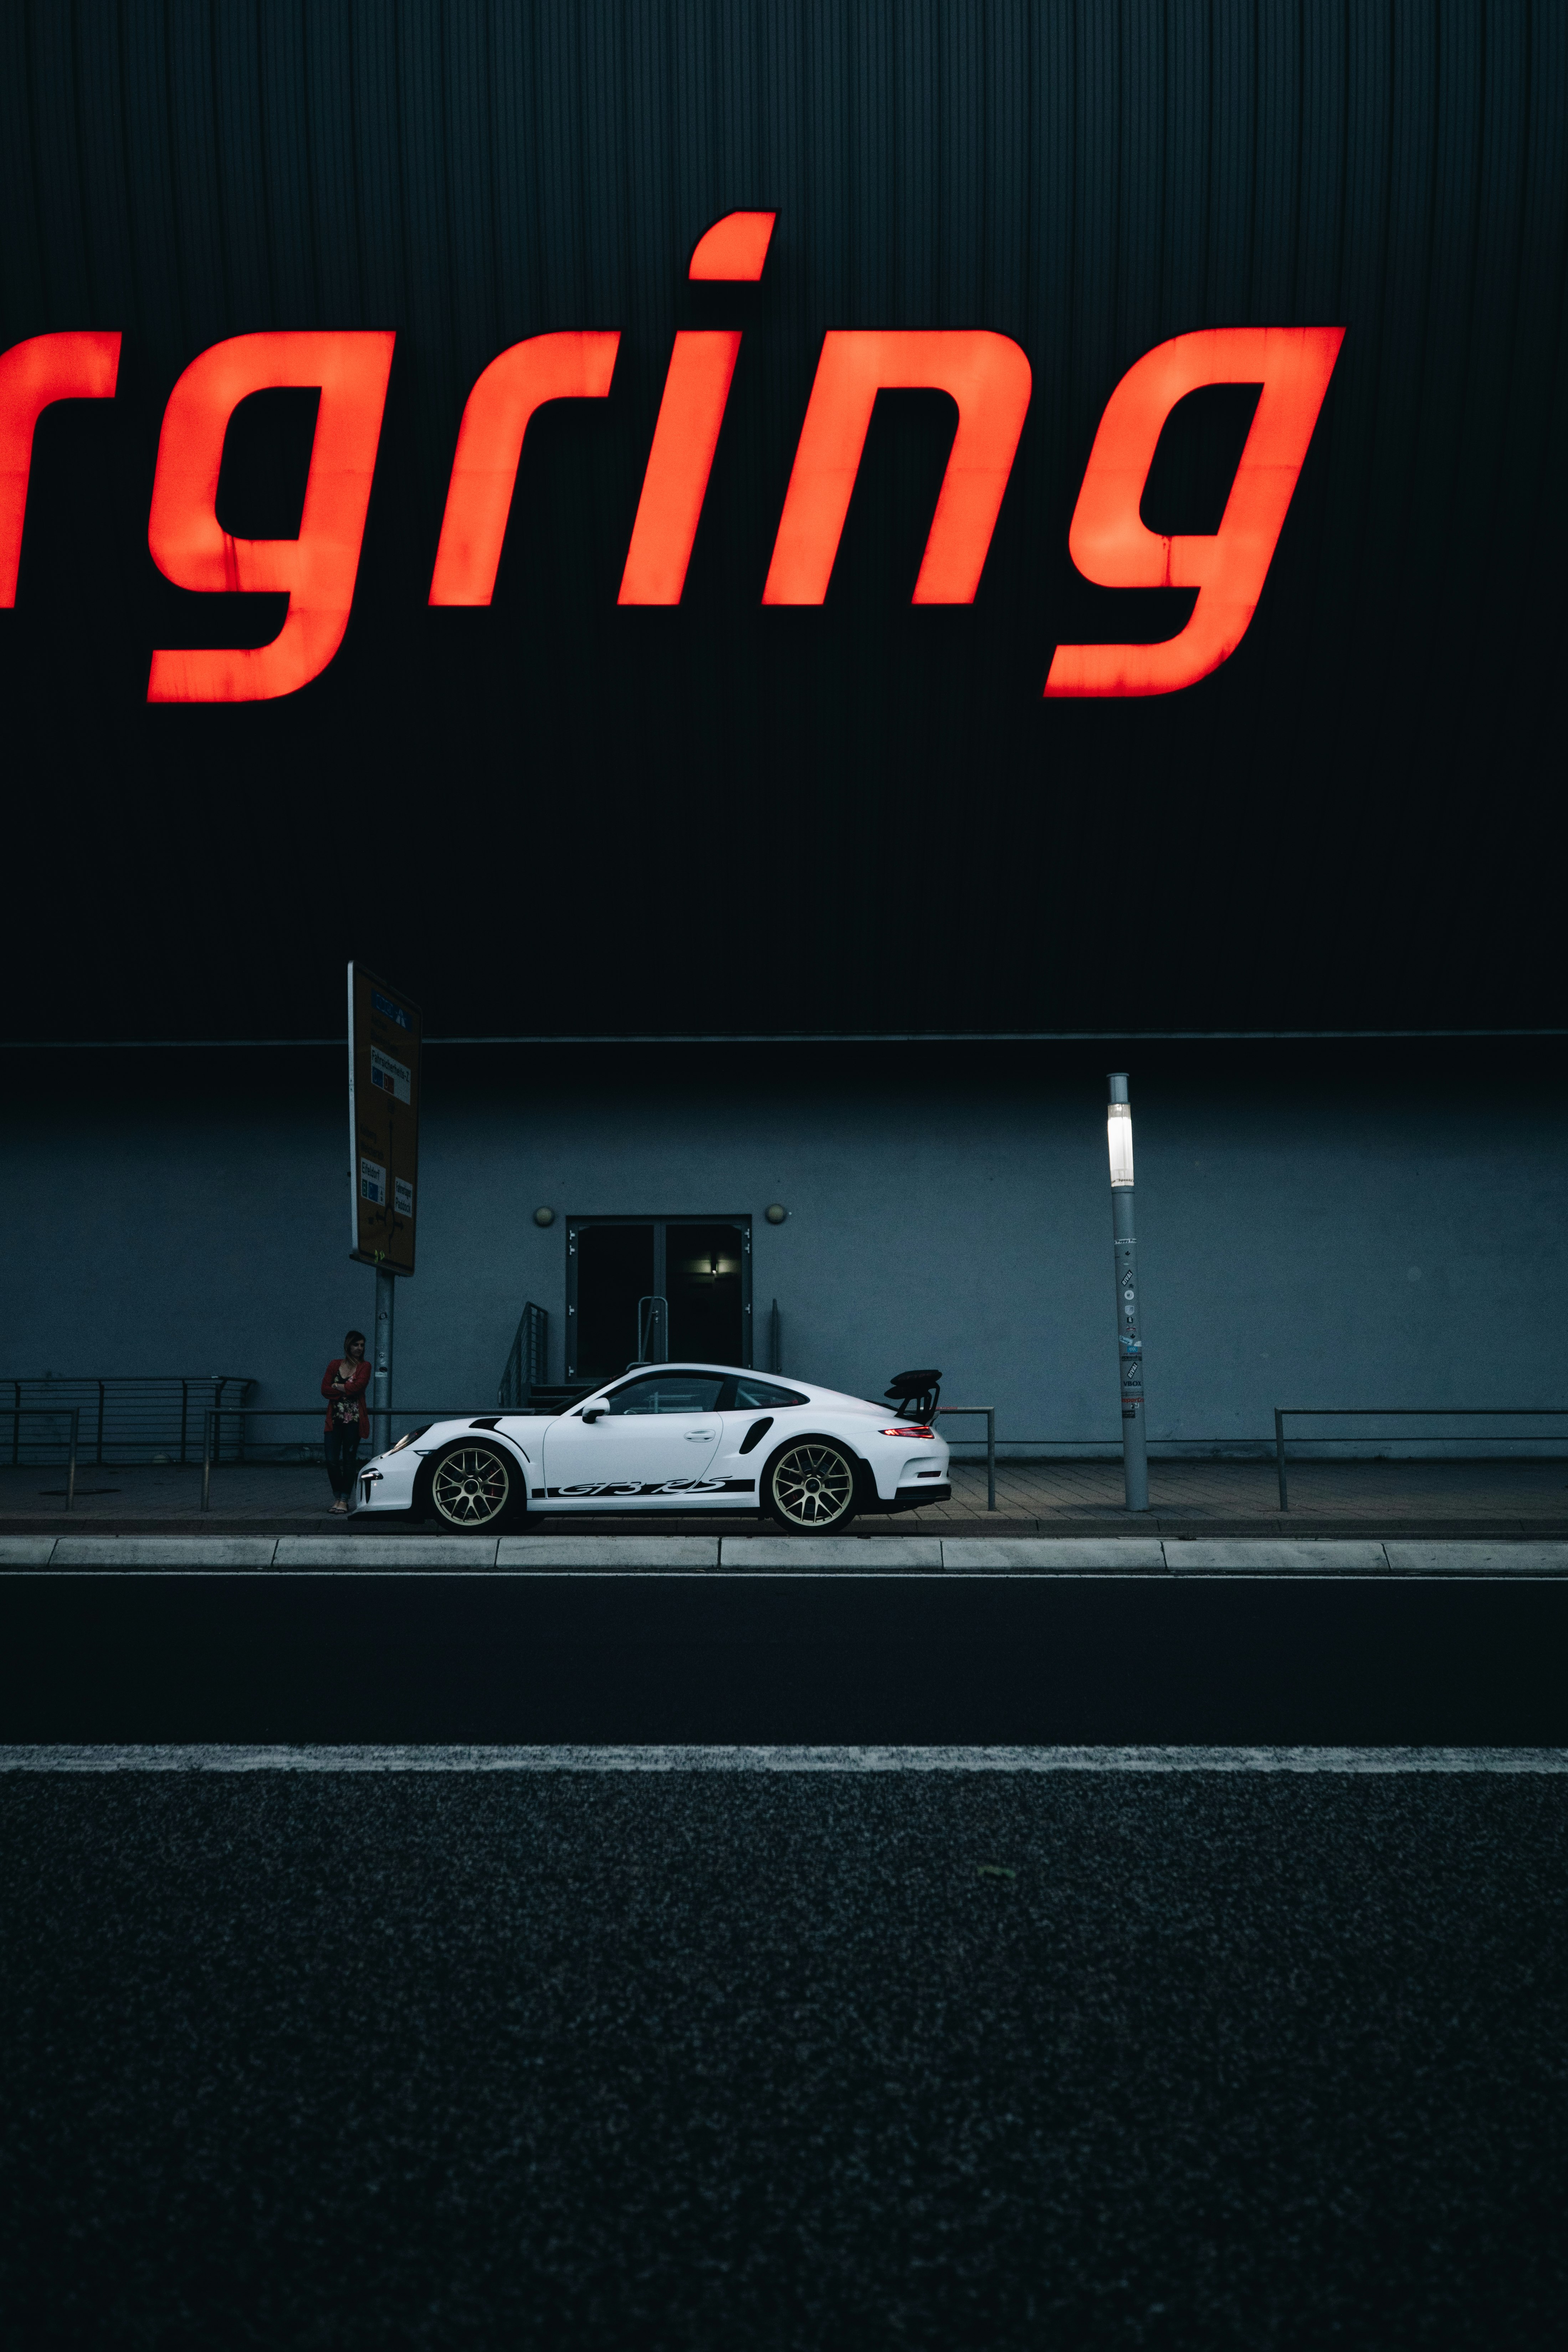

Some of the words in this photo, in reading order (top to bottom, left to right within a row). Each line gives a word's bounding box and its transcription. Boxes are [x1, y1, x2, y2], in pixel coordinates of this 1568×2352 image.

[0, 211, 1347, 702] rgring
[395, 1197, 411, 1213] Paddock
[1122, 1271, 1133, 1286] RIVAL
[1128, 1363, 1138, 1378] RIVAL
[558, 1481, 644, 1495] GT3
[650, 1476, 733, 1494] RS
